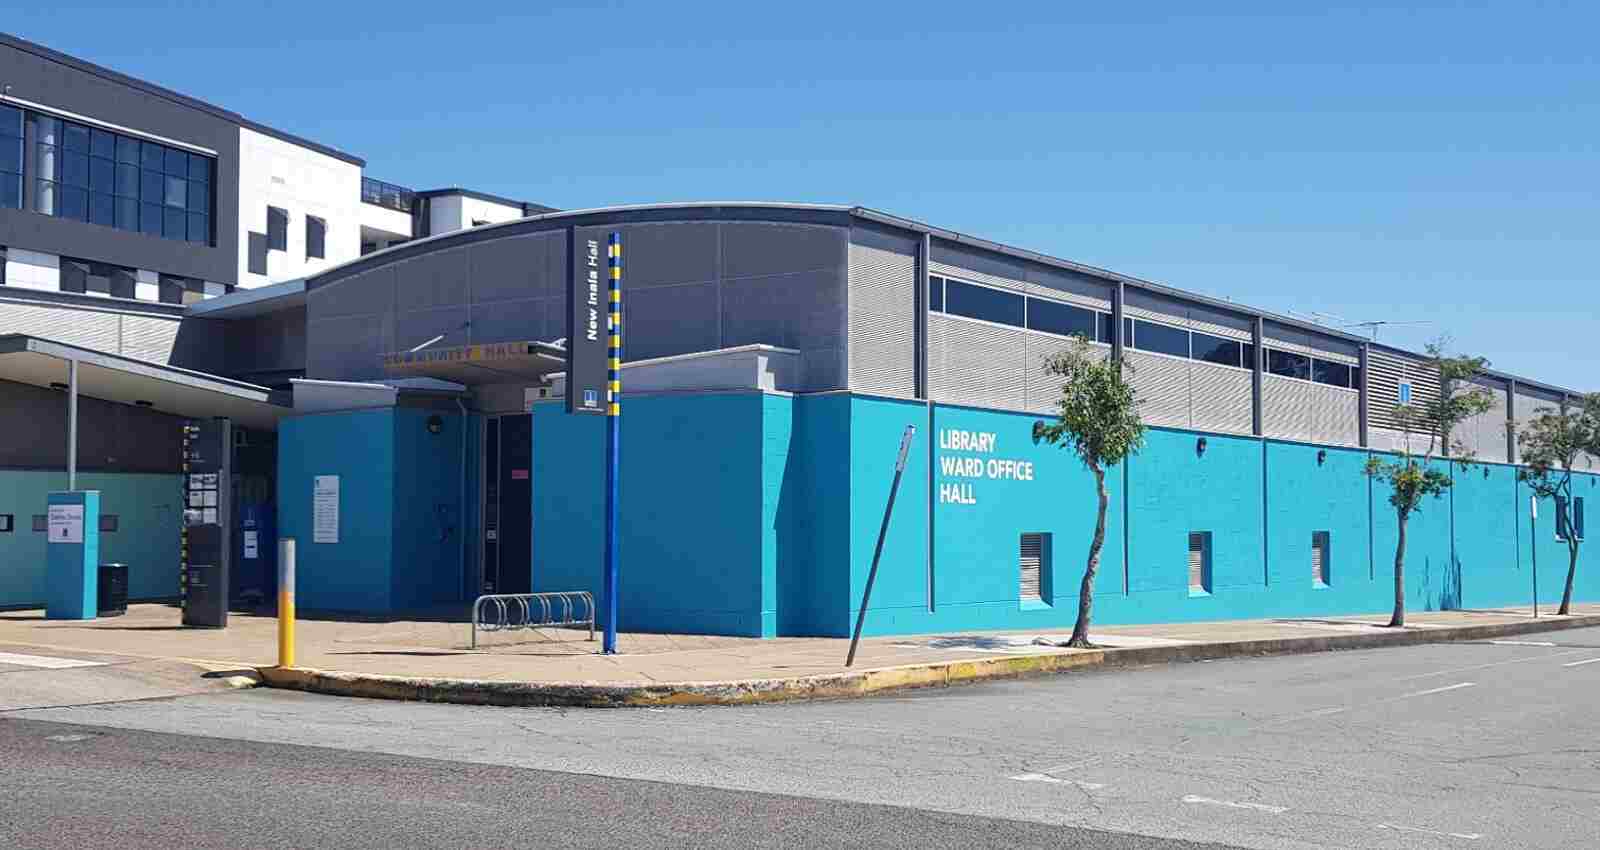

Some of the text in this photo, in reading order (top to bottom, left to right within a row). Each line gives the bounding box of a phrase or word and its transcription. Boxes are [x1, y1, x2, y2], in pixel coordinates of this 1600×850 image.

[587, 239, 598, 267] Hall
[587, 308, 598, 341] New
[940, 428, 996, 453] LIBRARY
[940, 456, 1033, 481] WARD OFFICE
[940, 483, 976, 505] HALL
